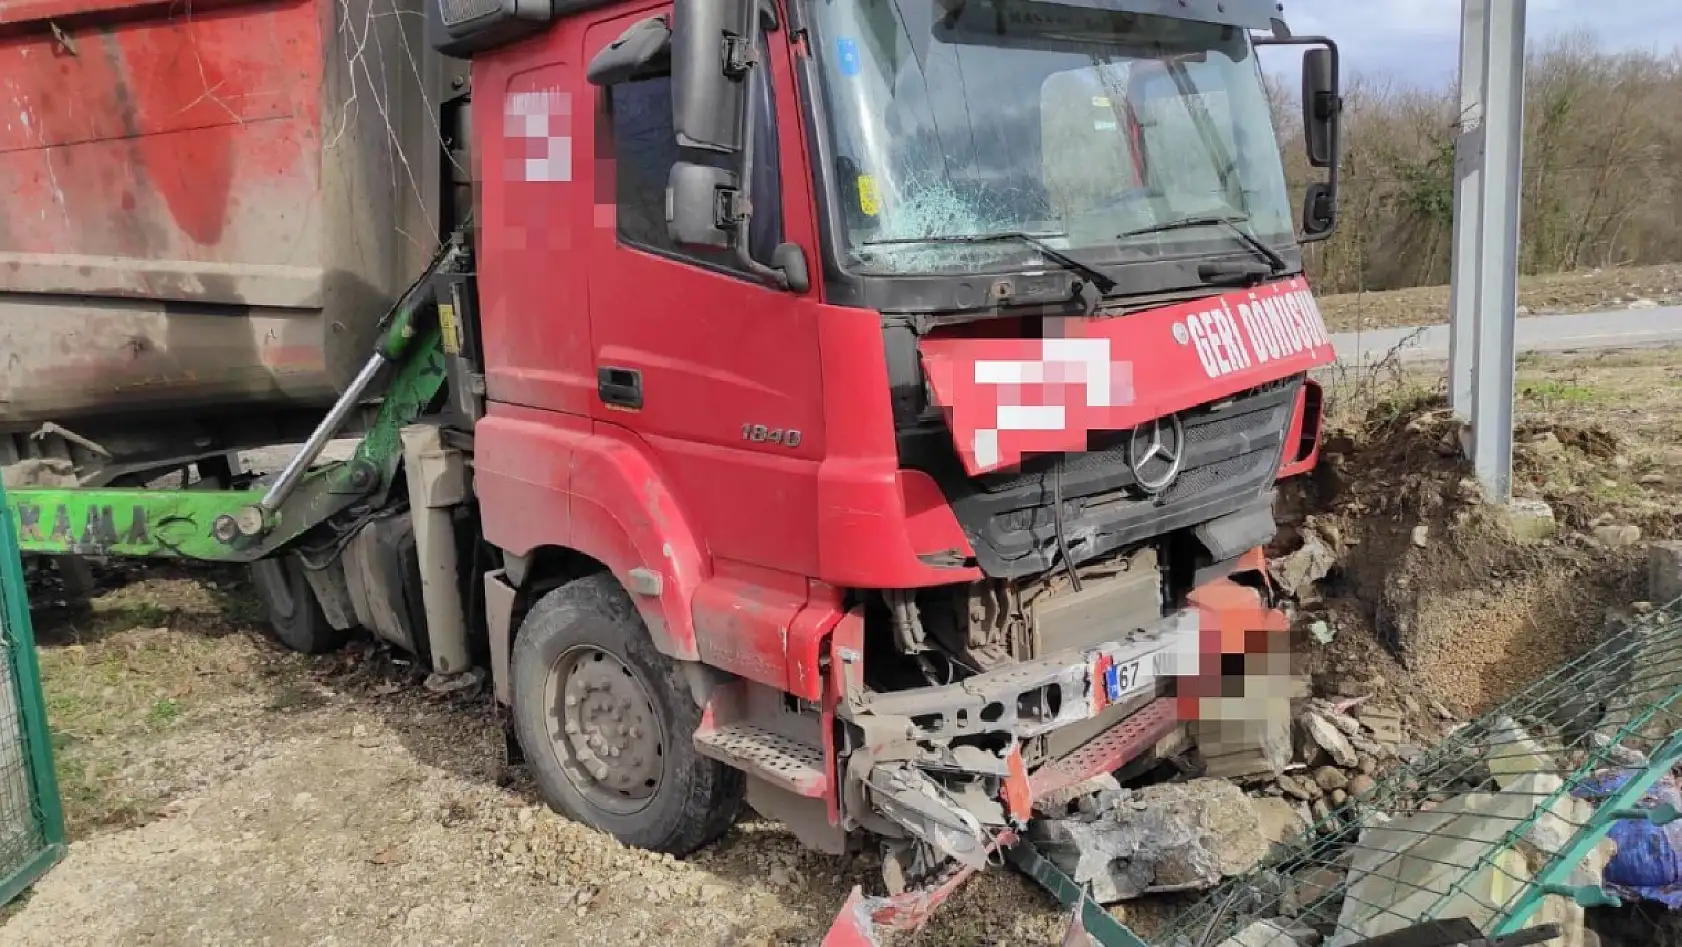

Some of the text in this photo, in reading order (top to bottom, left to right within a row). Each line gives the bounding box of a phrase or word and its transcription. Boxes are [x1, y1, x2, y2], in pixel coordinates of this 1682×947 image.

[1186, 296, 1251, 378] GERİ
[741, 424, 801, 447] 1840
[1119, 662, 1140, 690] 67
